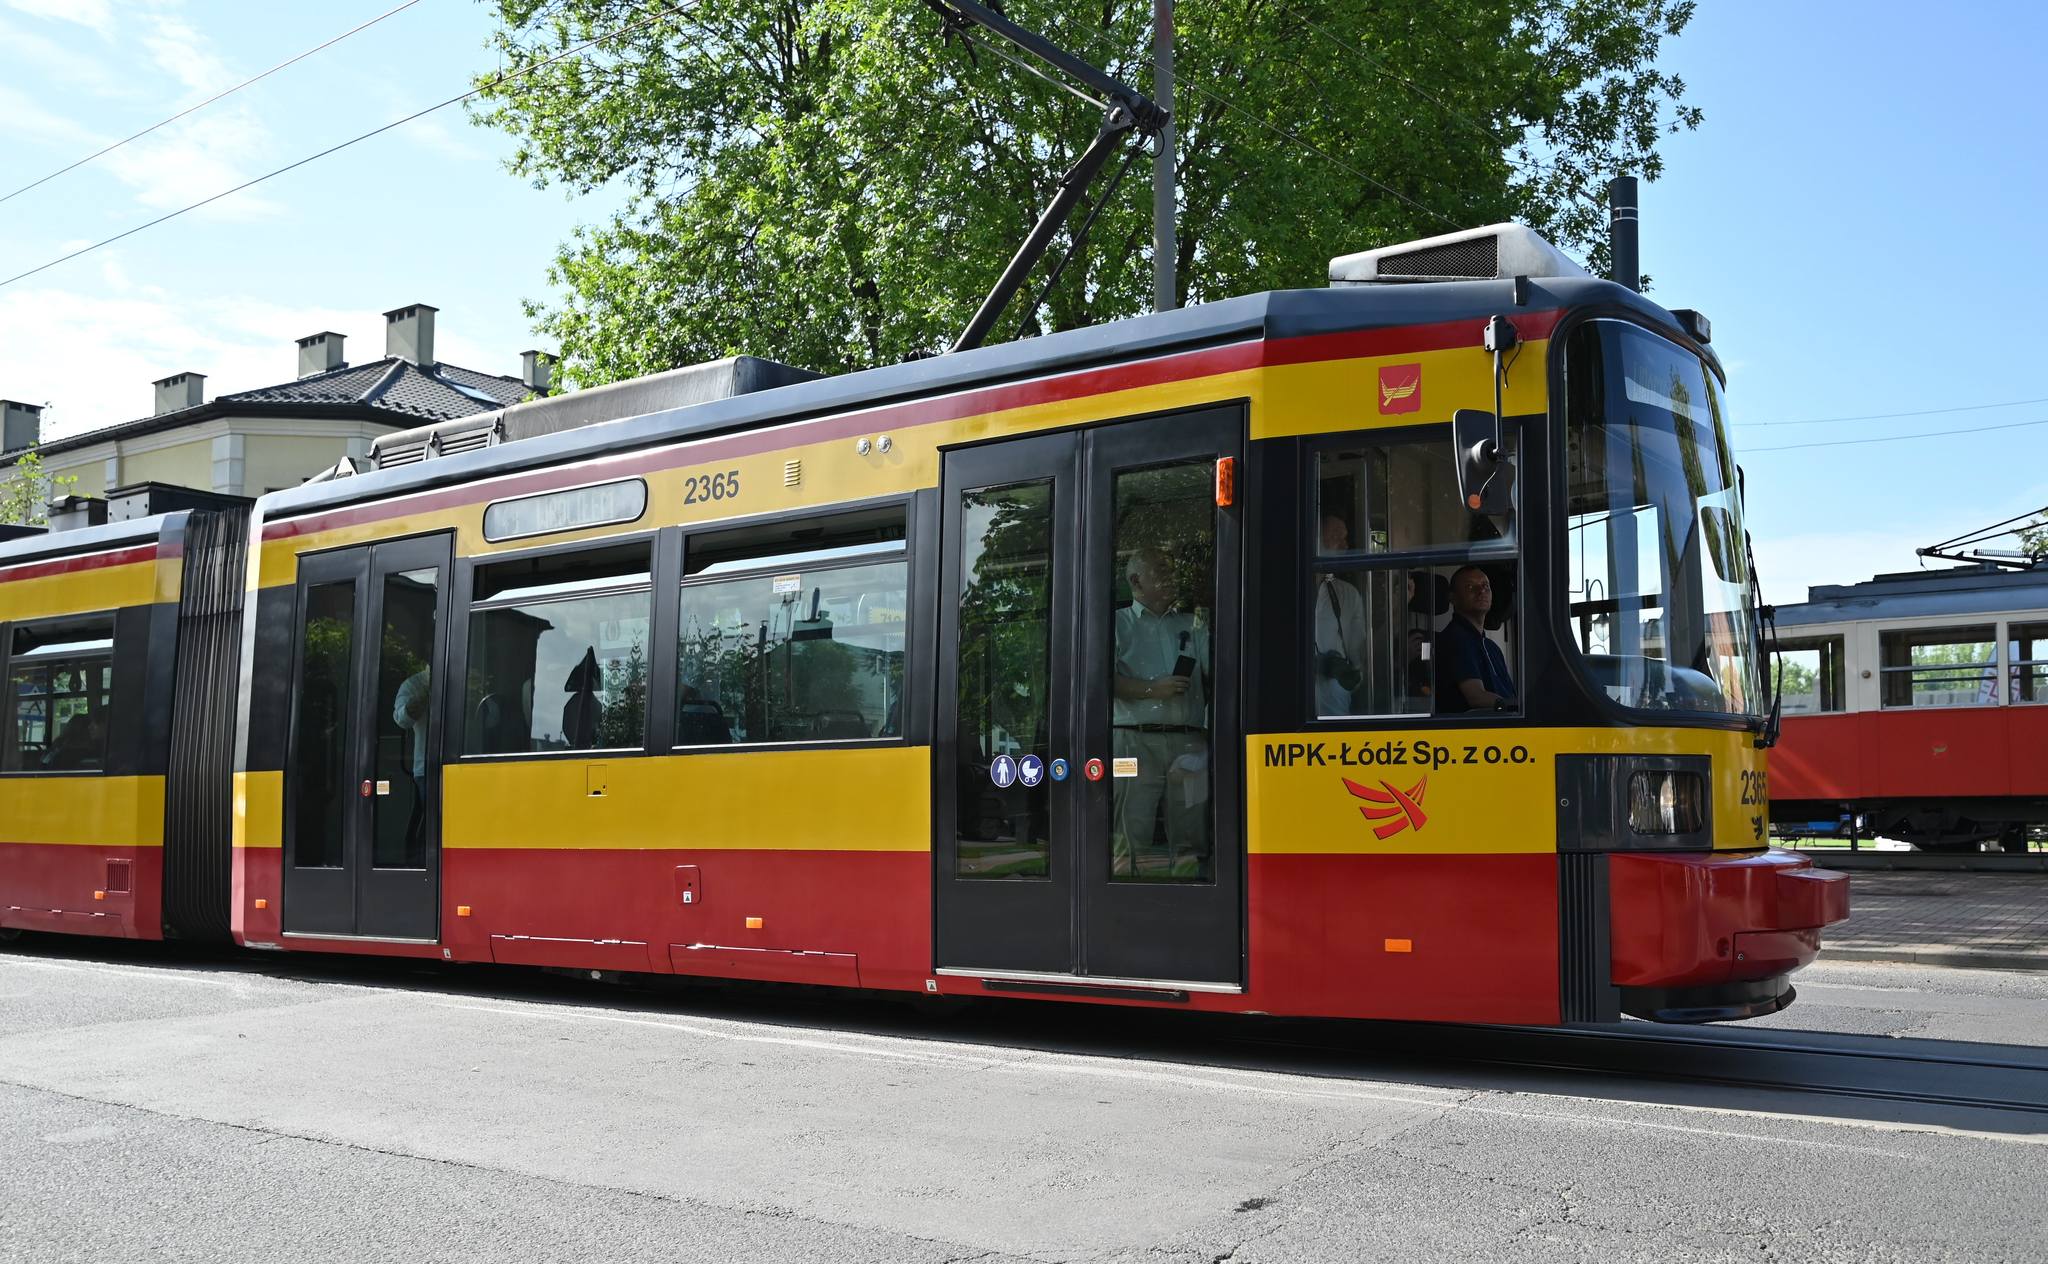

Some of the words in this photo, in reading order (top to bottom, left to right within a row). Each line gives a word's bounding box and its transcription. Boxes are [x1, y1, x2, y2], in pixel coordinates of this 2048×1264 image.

[684, 470, 740, 504] 2365
[1264, 741, 1407, 767] MPK-Łódź
[1413, 741, 1457, 770] Sp.
[1463, 746, 1478, 764] z
[1484, 745, 1536, 764] o.o.
[1741, 769, 1767, 805] 2365
